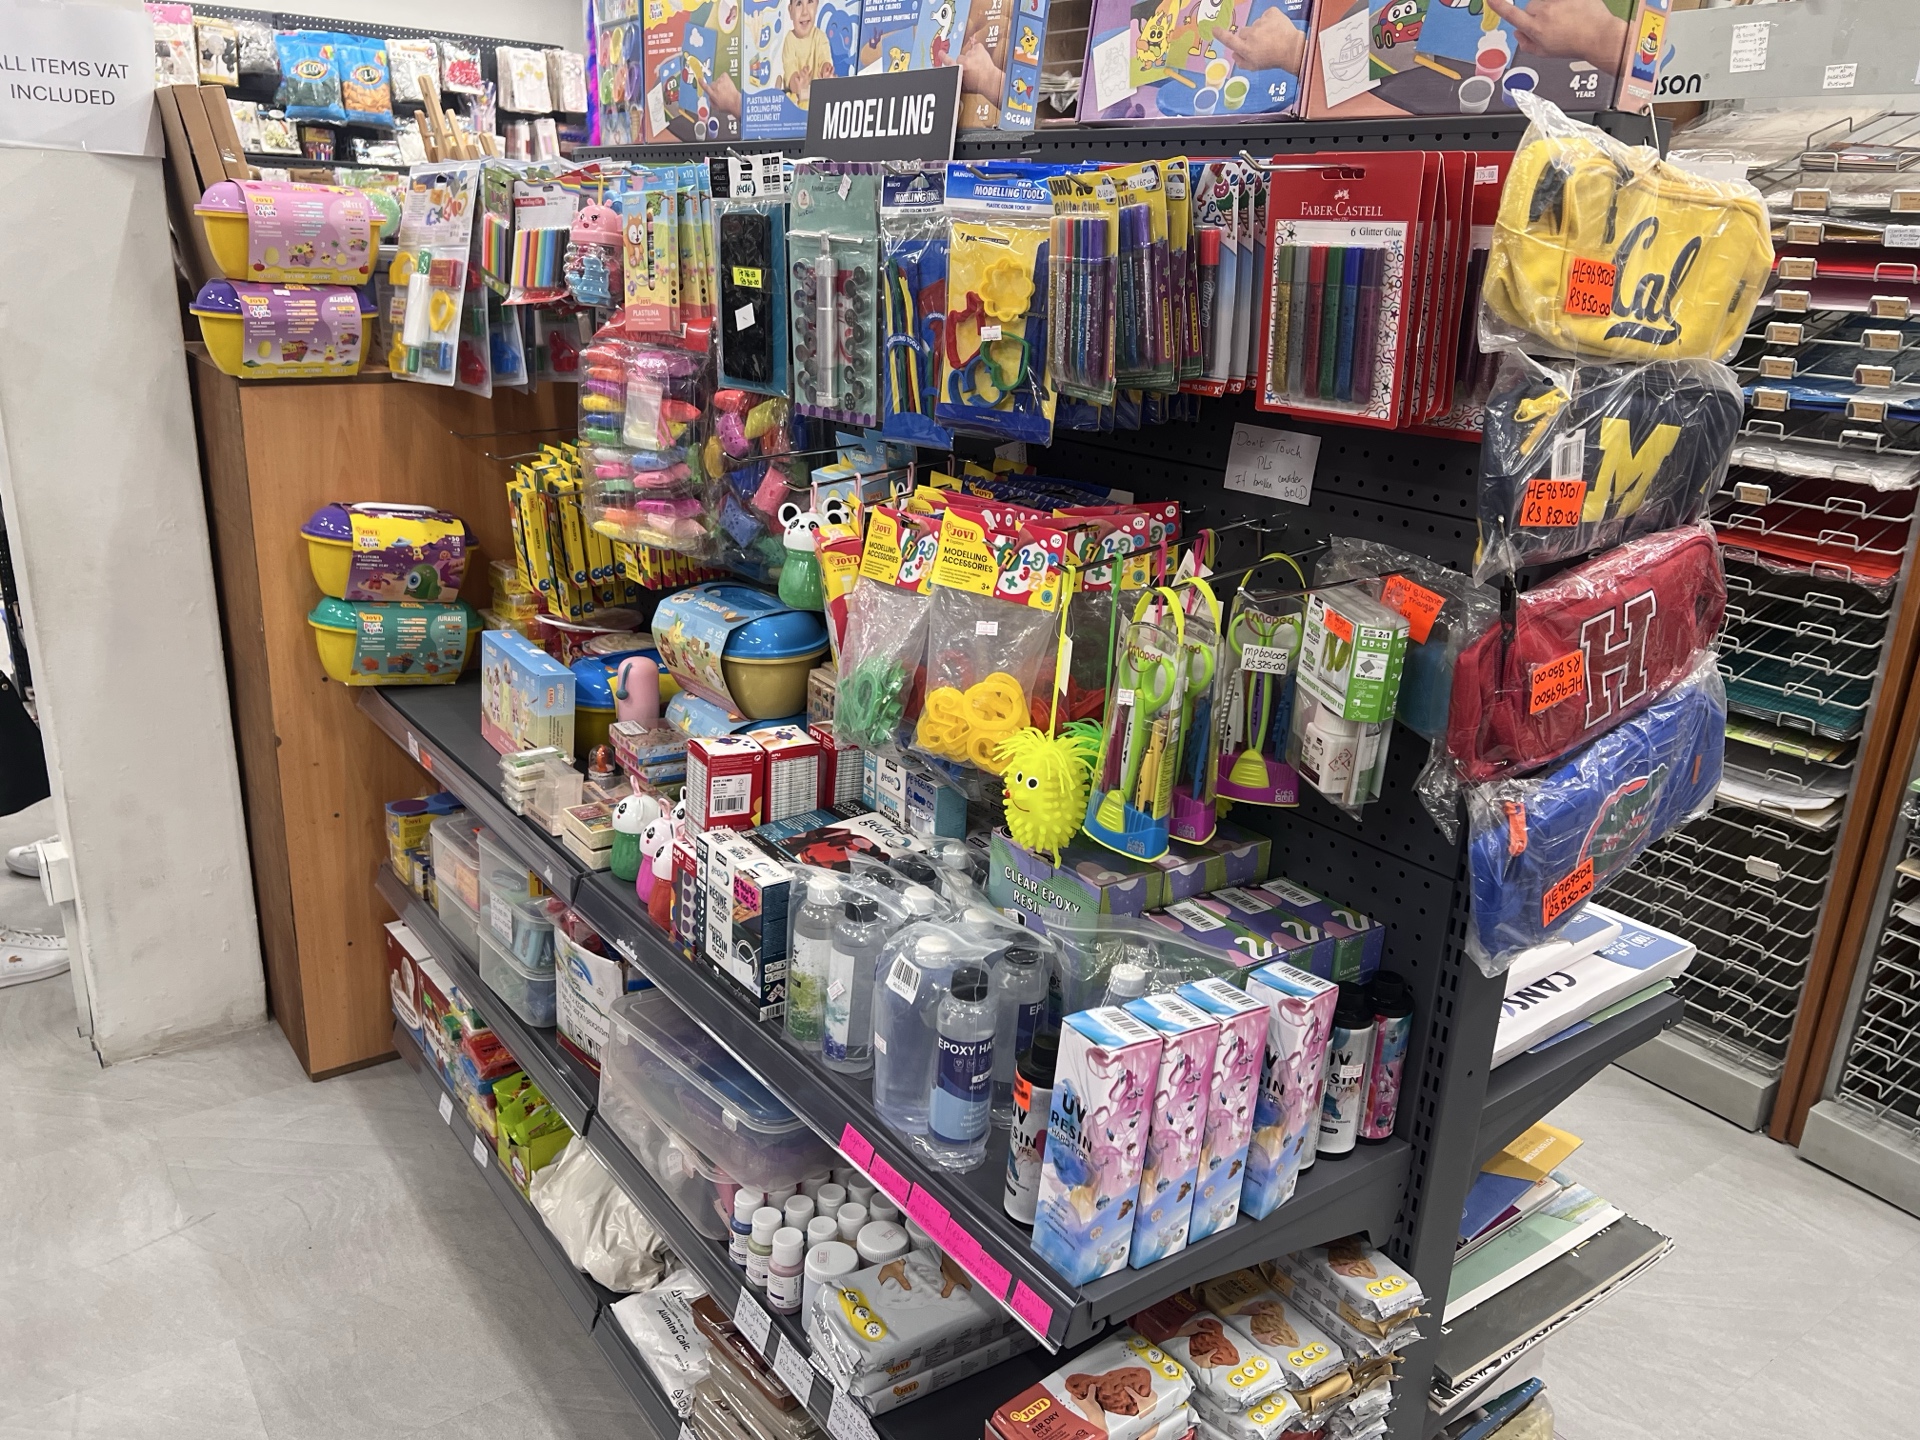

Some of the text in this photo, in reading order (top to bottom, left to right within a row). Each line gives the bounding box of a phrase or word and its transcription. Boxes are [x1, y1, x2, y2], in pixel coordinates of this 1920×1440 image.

[761, 29, 770, 42] x3
[989, 26, 999, 36] X8
[31, 57, 129, 79] ITEMS VAT
[760, 65, 769, 76] x4
[1268, 82, 1287, 96] 4-8
[1570, 75, 1597, 91] 4-8
[10, 83, 116, 106] INCLUDED
[771, 95, 785, 104] BABY
[1575, 90, 1596, 98] YEARS
[751, 104, 782, 113] ROLLING PINS
[976, 105, 989, 115] 4-8
[746, 112, 781, 122] MODELLING KIT
[822, 93, 936, 140] MODELLING
[1476, 171, 1495, 179] 175.00
[974, 185, 1046, 200] MODELLING TOOLS
[1048, 179, 1072, 196] UHU
[1300, 202, 1383, 217] FABER-CASTELL
[966, 234, 978, 244] pcs.
[1351, 227, 1403, 237] 6 Glitter Glue
[1572, 260, 1616, 288] HE969503
[1612, 216, 1701, 326] Cal
[1230, 381, 1241, 392] x9
[1235, 430, 1302, 459] Don't Touch
[1582, 417, 1682, 522] M
[1235, 470, 1247, 487] If
[1527, 481, 1581, 500] HE969501
[1526, 502, 1542, 523] RS
[874, 525, 891, 535] JOVI
[951, 528, 975, 541] JOVI
[868, 541, 897, 555] MODELLING
[1052, 537, 1061, 545] x12
[835, 555, 858, 567] JOVI
[867, 549, 899, 564] ACCESSORIES
[944, 546, 988, 563] MODELLING
[942, 555, 993, 573] ACCESSORIES
[981, 582, 990, 591] 3+
[437, 615, 461, 623] JURASSIC
[1251, 612, 1295, 626] Maped
[1132, 644, 1162, 664] Maped
[1579, 589, 1657, 729] H
[1534, 674, 1582, 706] HE969500
[810, 730, 821, 740] APLI
[1275, 788, 1293, 796] Créa
[880, 809, 901, 826] MOULAGE
[1177, 822, 1195, 832] Créa
[1127, 837, 1144, 846] Créa
[673, 848, 684, 860] APLI
[1005, 866, 1081, 915] CLEAR EPOXY
[1221, 877, 1246, 889] CAUTION
[1544, 866, 1592, 909] HE969502
[1014, 889, 1045, 916] RESIN
[712, 933, 728, 953] RESIN
[712, 944, 725, 959] GLAZE
[1340, 965, 1361, 976] CAUTION
[938, 1037, 976, 1056] EPOXY
[1063, 1089, 1088, 1124] UV
[1051, 1110, 1092, 1153] RESIN
[1015, 1144, 1032, 1157] TYPE
[1051, 1129, 1088, 1162] HARD TYPE
[656, 1308, 681, 1341] Alumina
[675, 1335, 690, 1353] Calc.
[892, 1360, 911, 1373] JOVI
[900, 1382, 918, 1395] JOVI
[1022, 1400, 1049, 1420] JOVI
[1032, 1412, 1059, 1434] AIR DRY
[1037, 1426, 1053, 1439] CLAY
